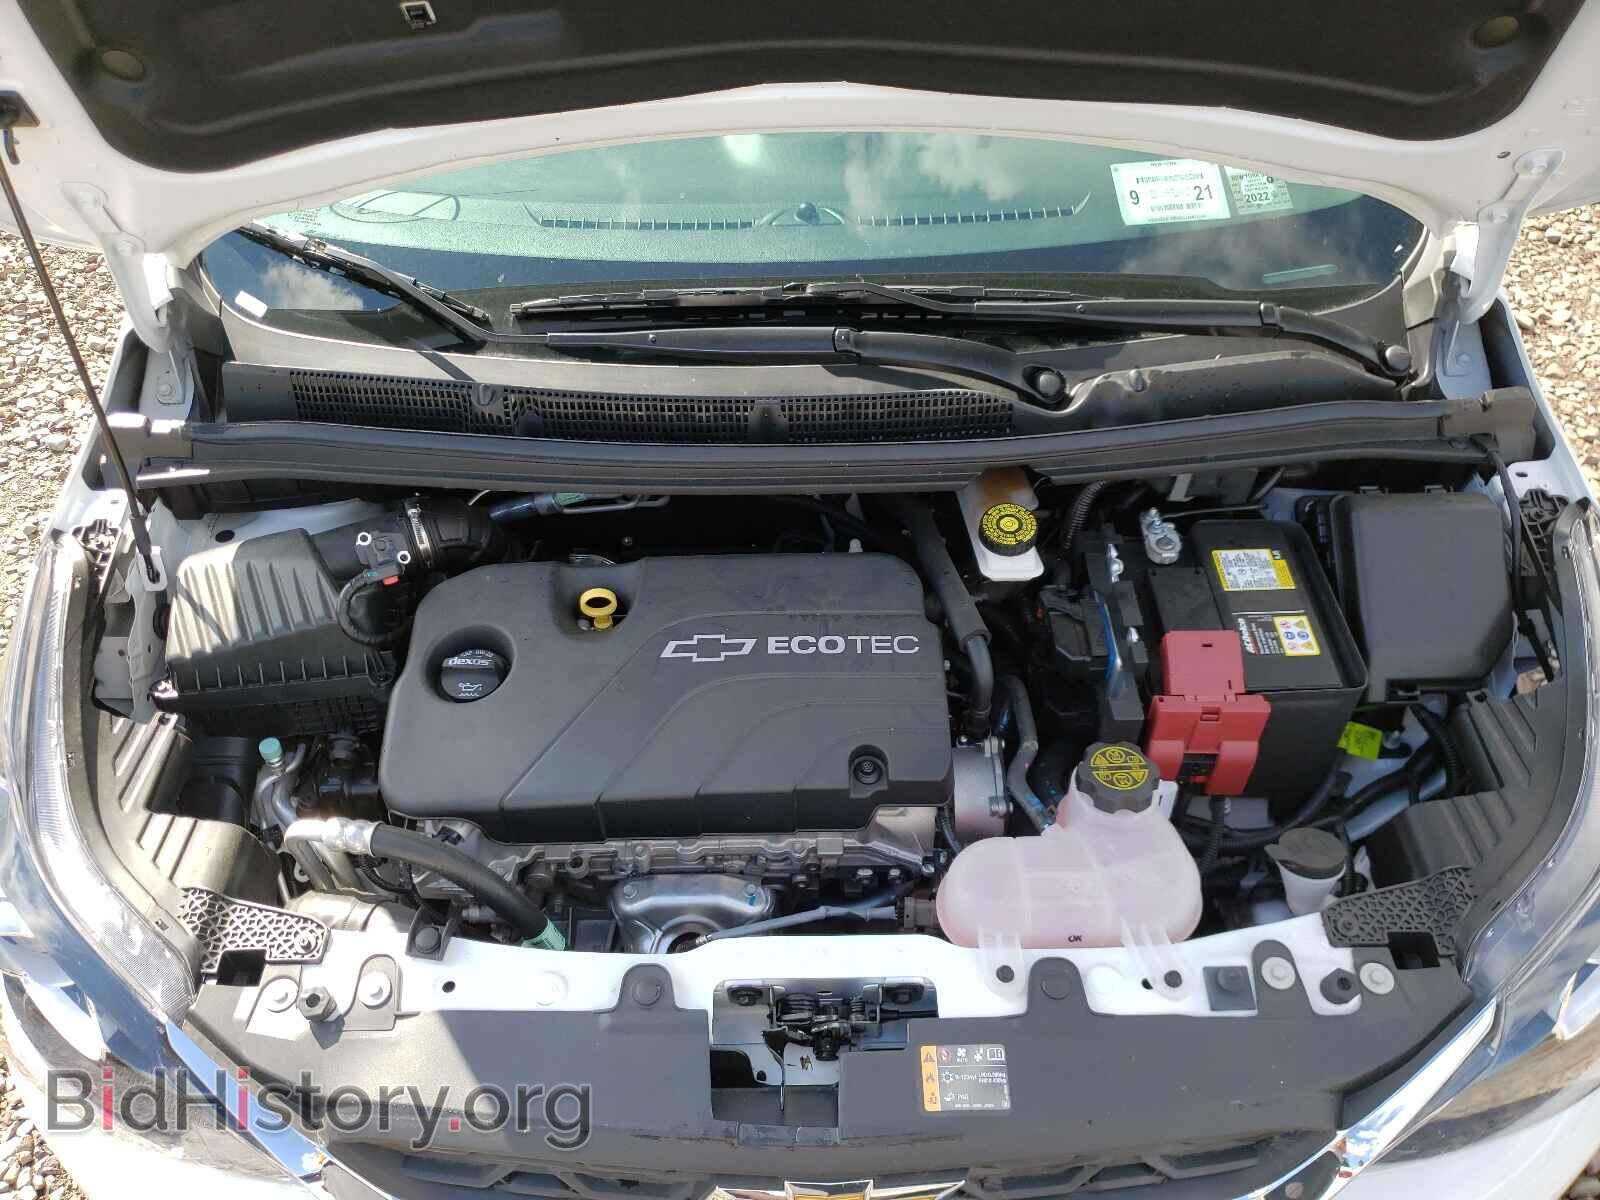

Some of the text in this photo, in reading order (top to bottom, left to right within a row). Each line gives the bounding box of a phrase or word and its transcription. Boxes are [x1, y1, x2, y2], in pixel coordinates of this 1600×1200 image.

[1129, 189, 1140, 206] 9
[1193, 184, 1213, 201] 21
[1245, 191, 1271, 203] 2022
[767, 635, 920, 655] ECOTEC
[448, 656, 491, 666] dexos
[1068, 934, 1083, 943] OK
